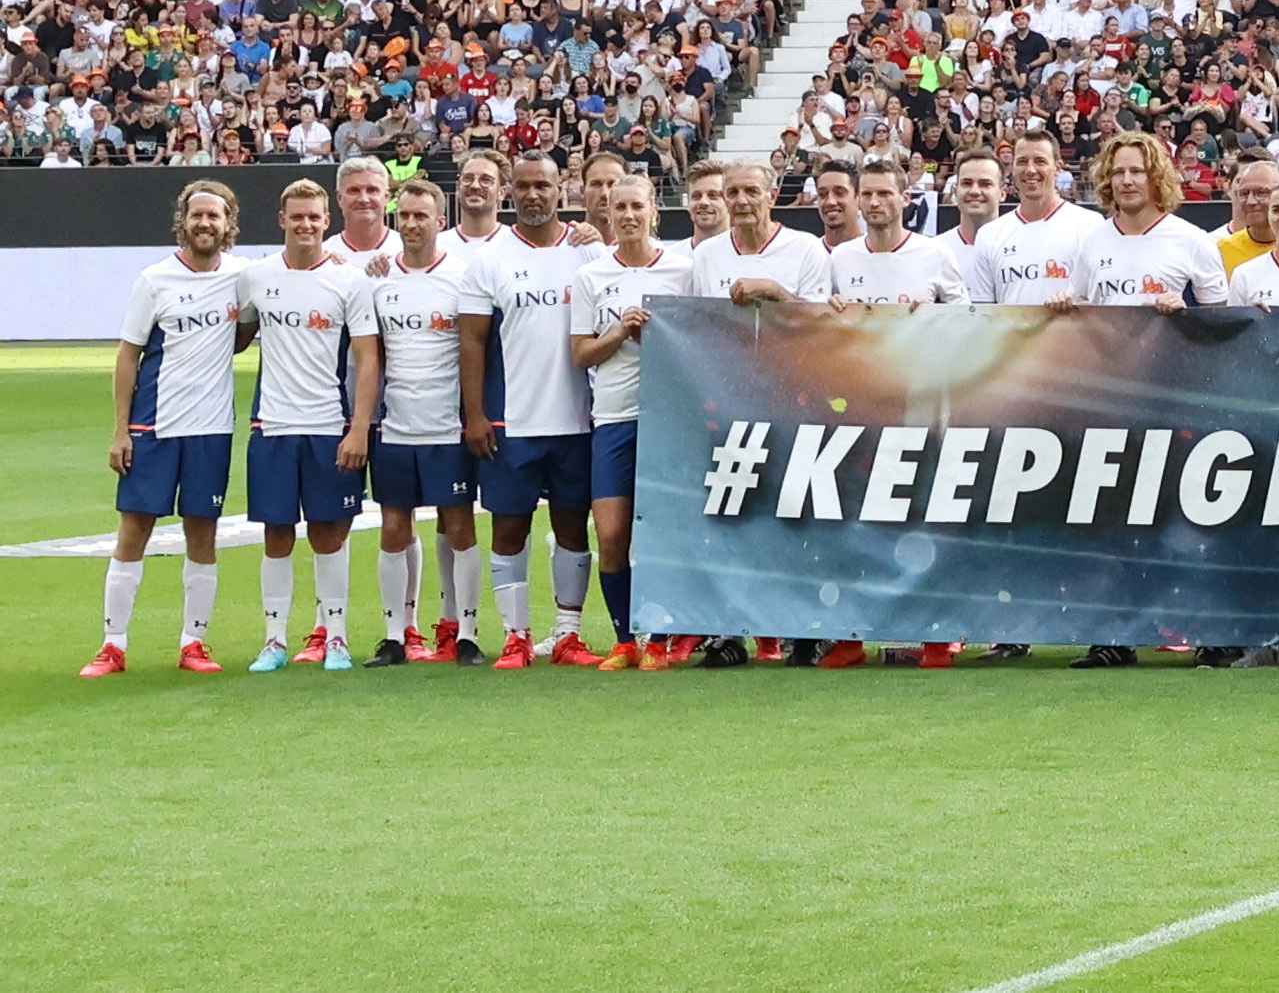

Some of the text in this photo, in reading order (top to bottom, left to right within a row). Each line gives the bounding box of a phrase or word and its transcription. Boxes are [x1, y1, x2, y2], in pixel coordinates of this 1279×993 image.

[1001, 264, 1040, 284] ING
[514, 288, 559, 308] ING
[1098, 279, 1137, 298] ING
[177, 309, 221, 333] ING
[261, 310, 301, 329] ING
[382, 311, 422, 331] ING
[598, 306, 622, 325] IN
